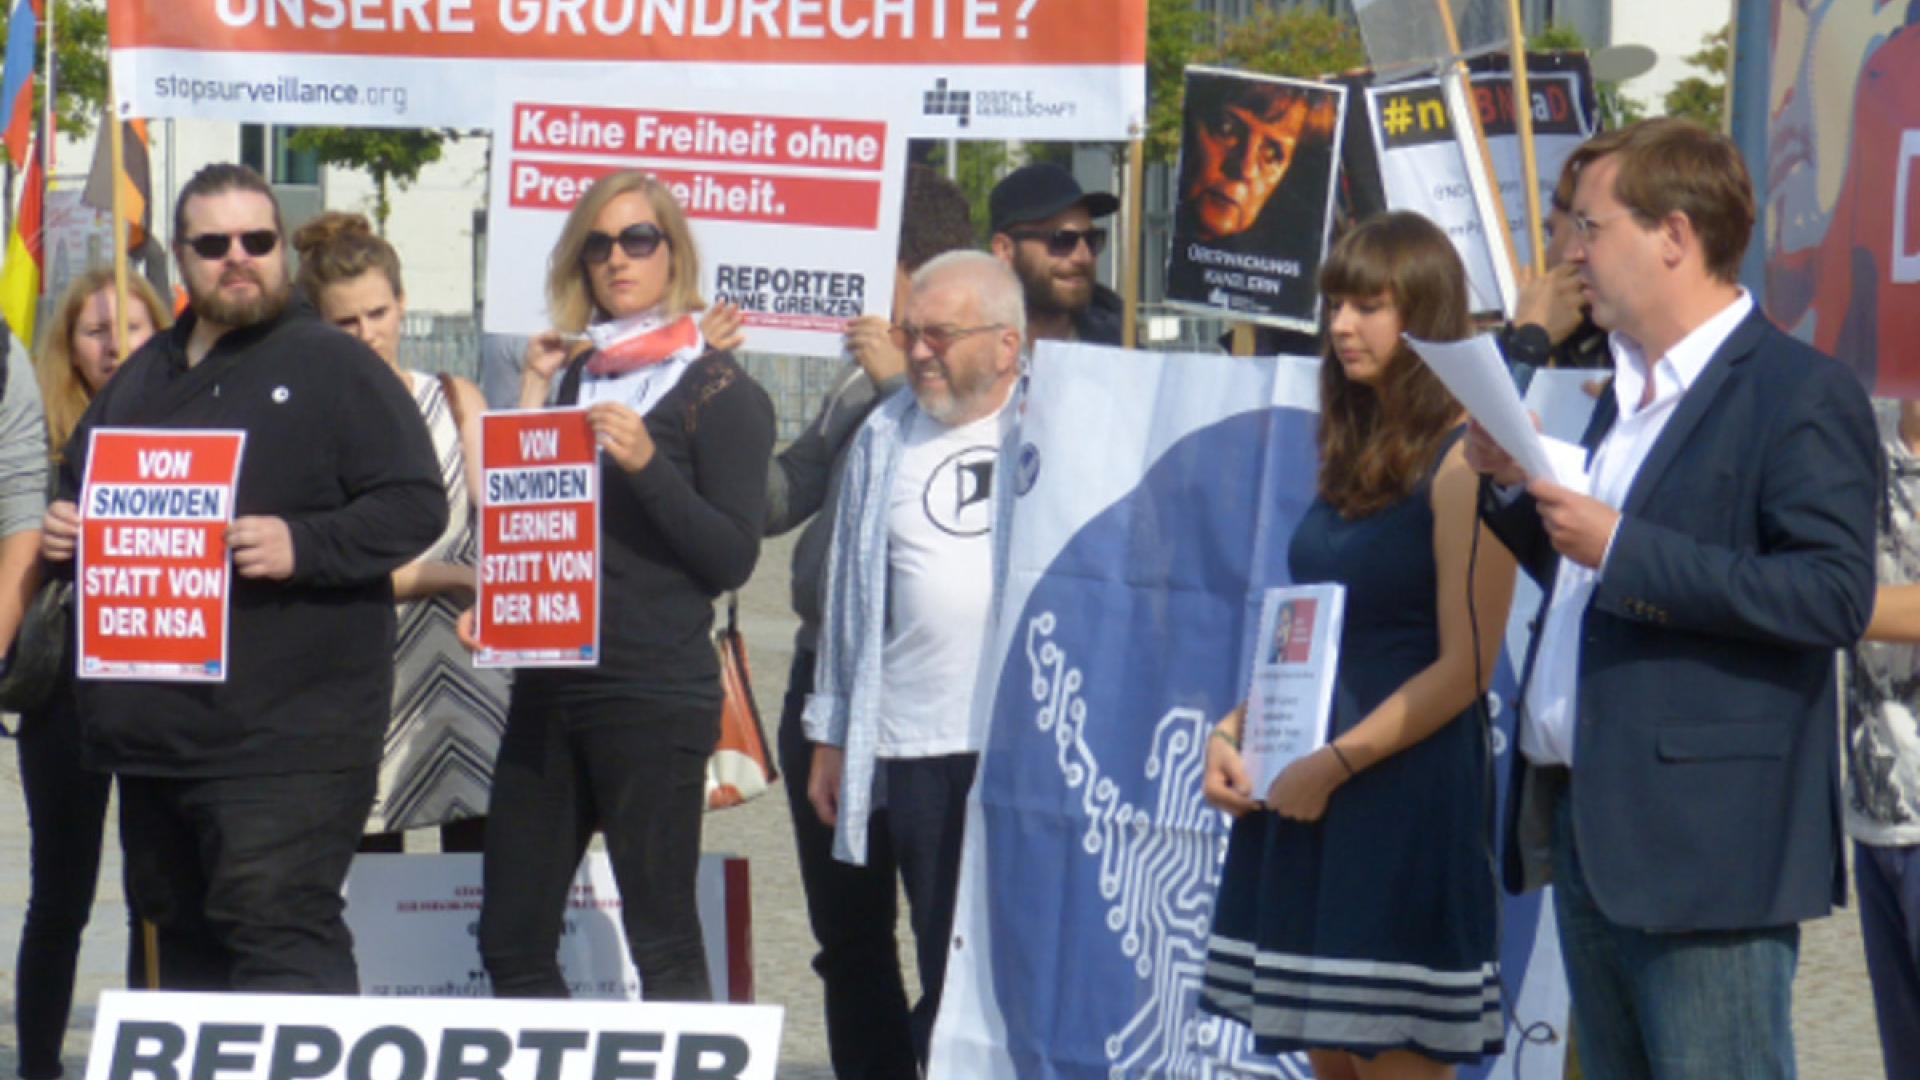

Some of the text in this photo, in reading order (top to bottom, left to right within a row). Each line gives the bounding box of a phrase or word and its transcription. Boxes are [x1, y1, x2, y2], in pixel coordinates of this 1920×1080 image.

[214, 0, 475, 33] UNSERE
[155, 75, 407, 114] stopsurveillance.org
[520, 110, 878, 161] Keine Freiheit ohne
[717, 264, 865, 297] REPORTER
[774, 294, 863, 317] GRENZEN
[517, 429, 558, 461] VON
[138, 449, 192, 479] VON
[94, 487, 219, 517] SNOWDEN
[489, 469, 587, 502] SNOWDEN
[104, 526, 206, 558] LERNEN
[500, 510, 577, 543] LERNEN
[85, 566, 222, 599] STATT VON
[485, 551, 593, 585] STATT VON
[100, 606, 206, 638] DER NSA
[493, 591, 581, 625] DER NSA
[107, 1020, 750, 1080] REPORTER
